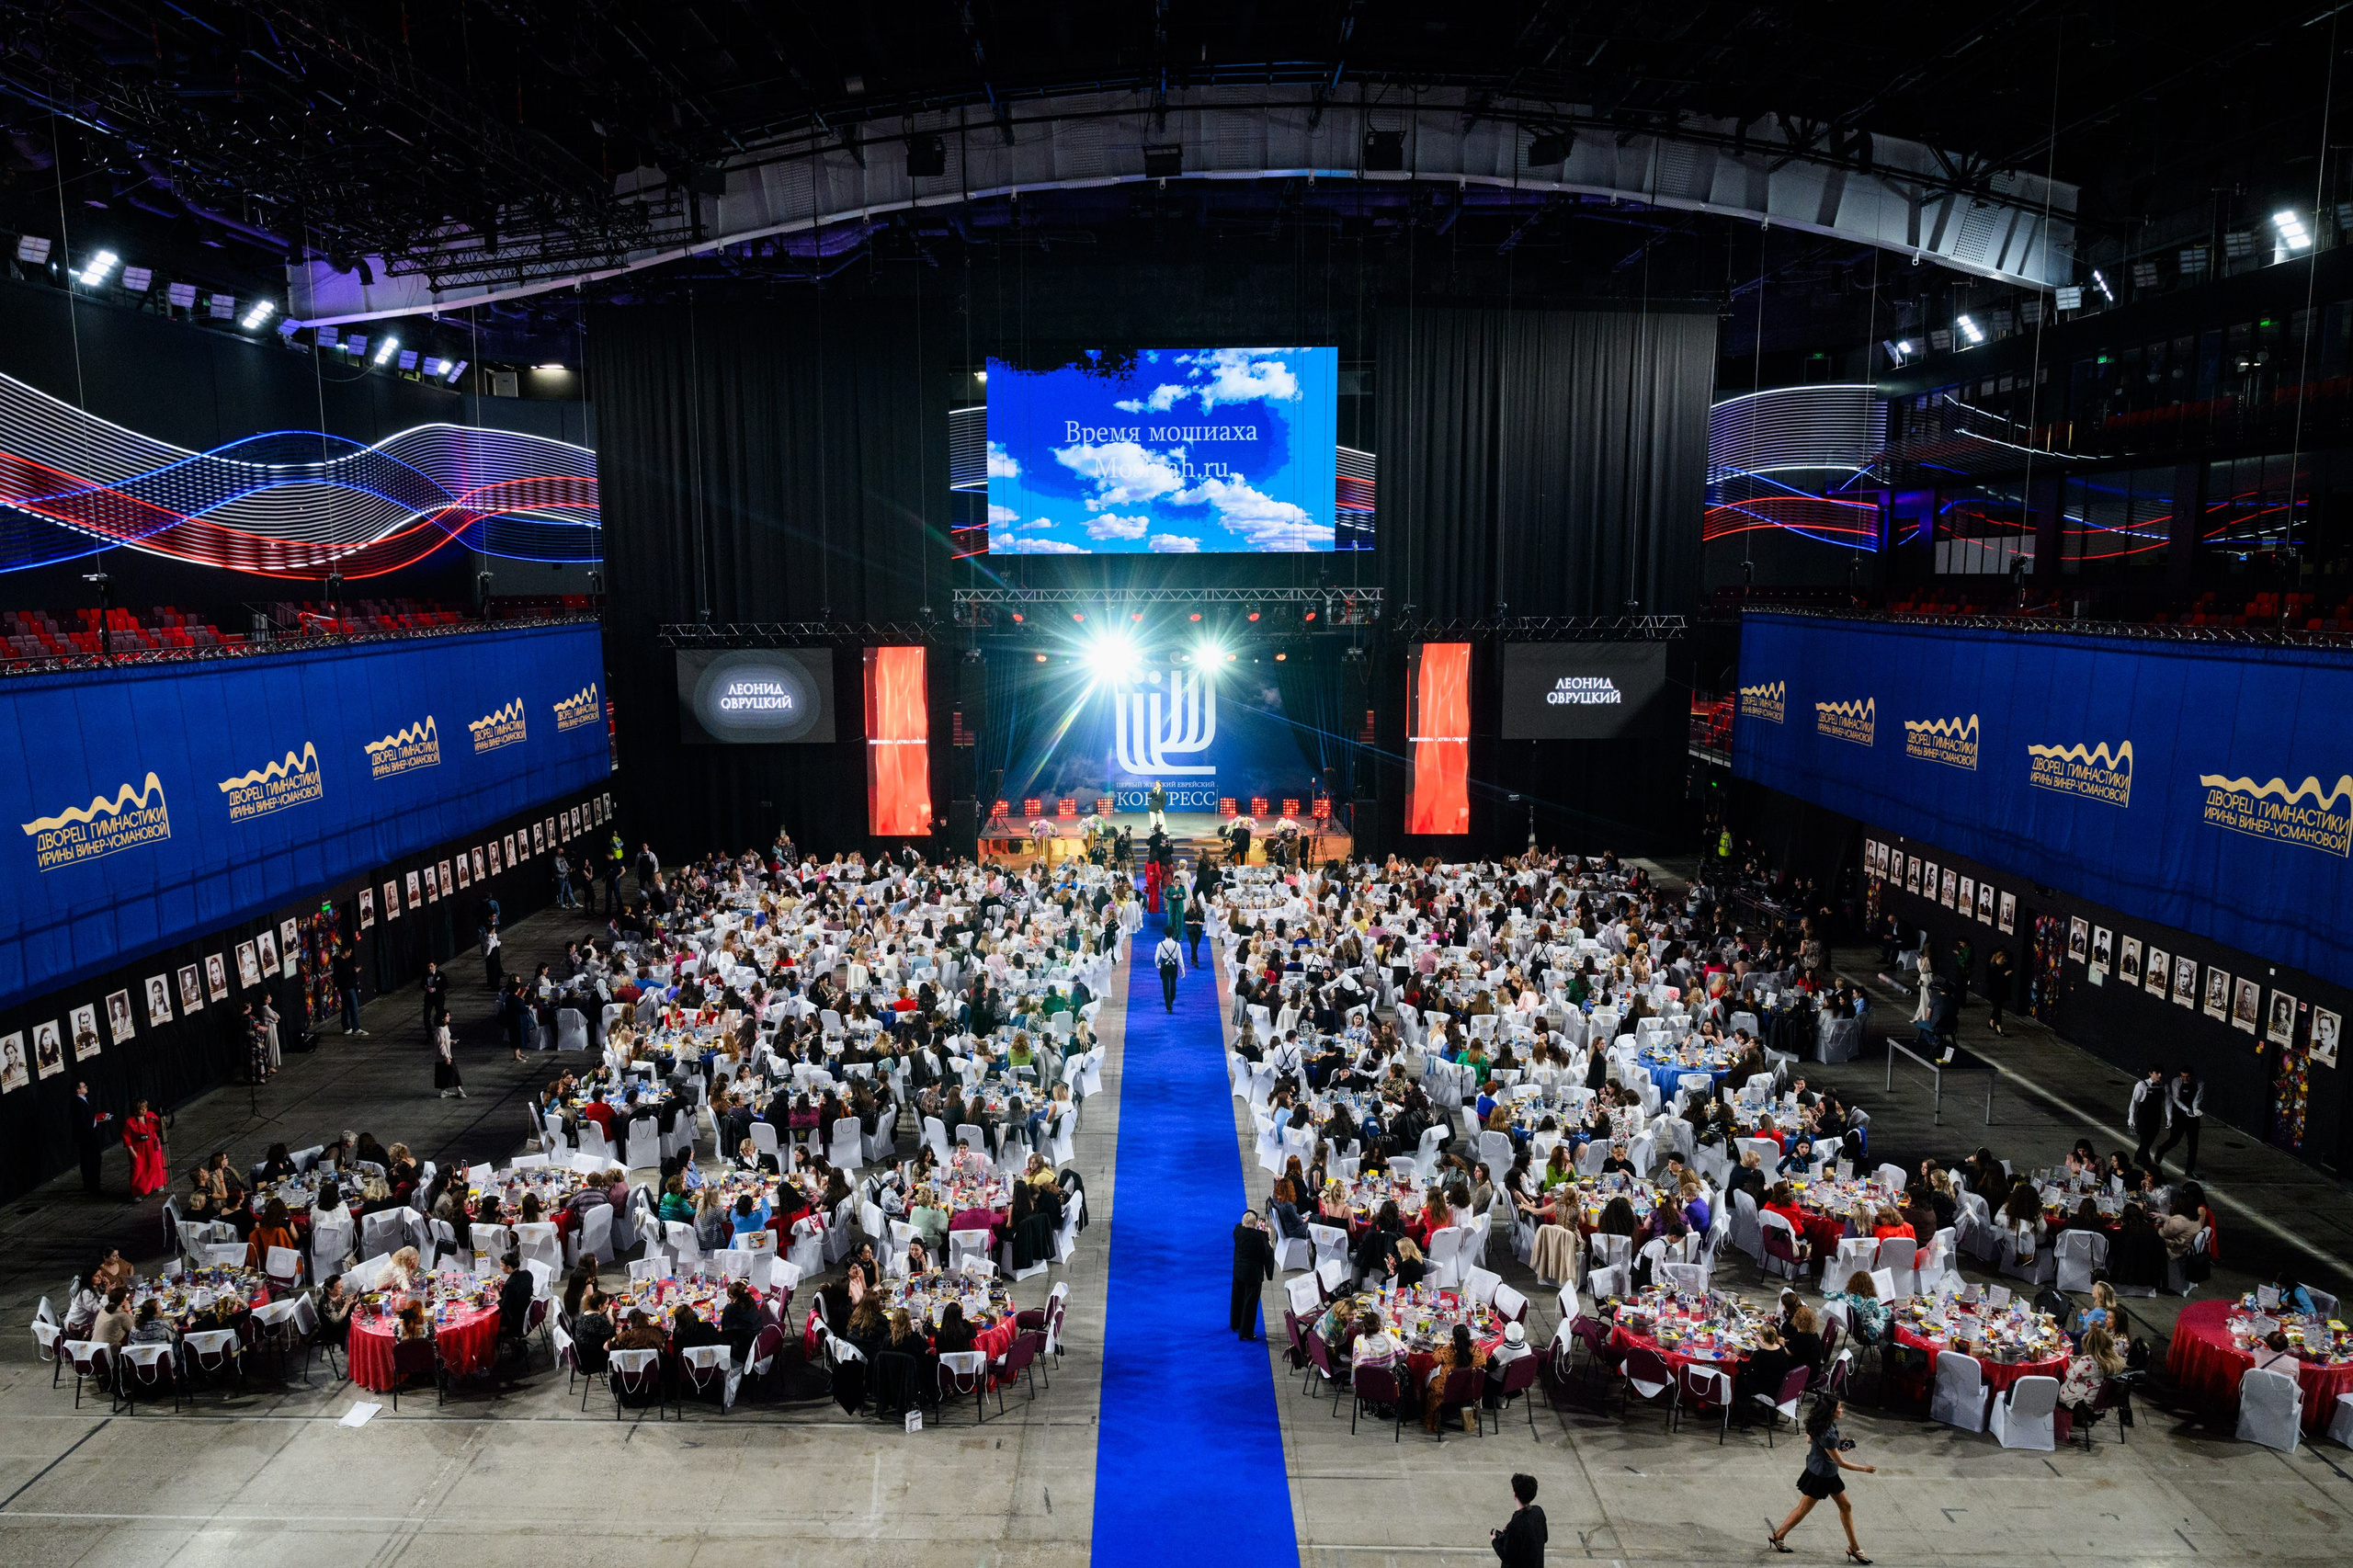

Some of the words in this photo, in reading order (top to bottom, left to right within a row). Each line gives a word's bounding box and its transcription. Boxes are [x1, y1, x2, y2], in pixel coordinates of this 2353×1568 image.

[1064, 420, 1141, 448] Время
[1149, 424, 1258, 442] мошиаха
[728, 683, 784, 696] ЛЕОНИД
[1555, 677, 1614, 689] ЛЕОНИД
[721, 695, 792, 710] ОВРУЦКИЙ
[1547, 689, 1621, 706] ОВРУЦКИЙ
[474, 727, 494, 742] ДВОРЕЦ
[494, 720, 525, 736] ГИМНАСТИКИ
[1818, 711, 1838, 725] ДВОРЕЦ
[1839, 716, 1873, 733] ГИМНАСТИКИ
[371, 749, 397, 766] ДВОРЕЦ
[398, 740, 438, 759] ГИМНАСТИКИ
[1906, 744, 1923, 756] ИРИНЫ
[1923, 746, 1975, 767] ВИНЕР-УСМАНОВОЙ
[1907, 732, 1931, 746] ДВОРЕЦ
[1932, 735, 1976, 755] ГИМНАСТИКИ
[372, 763, 391, 777] ИРИНЫ
[391, 752, 439, 772] ВИНЕР-УСМАНОВОЙ
[2031, 756, 2064, 776] ДВОРЕЦ
[2067, 763, 2129, 790] ГИМНАСТИКИ
[229, 785, 264, 806] ДВОРЕЦ
[266, 770, 319, 797] ГИМНАСТИКИ
[1117, 791, 1215, 806] КОНРЕСС
[2030, 771, 2053, 786] ИРИНЫ
[2053, 776, 2127, 803] ВИНЕР-УСМАНОВОЙ
[230, 802, 256, 819] ИРИНЫ
[256, 783, 321, 812] ВИНЕР-УСМАНОВОЙ
[2206, 789, 2255, 815] ДВОРЕЦ
[2257, 801, 2350, 835] ГИМНАСТИКИ
[37, 825, 87, 852] ДВОРЕЦ
[90, 806, 165, 839] ГИМНАСТИКИ
[2204, 806, 2237, 826] ИРИНЫ
[2238, 814, 2347, 852] ВИНЕР-УСМАНОВОЙ
[38, 846, 74, 868] ИРИНЫ
[75, 822, 167, 858] ВИНЕР-УСМАНОВОЙ
